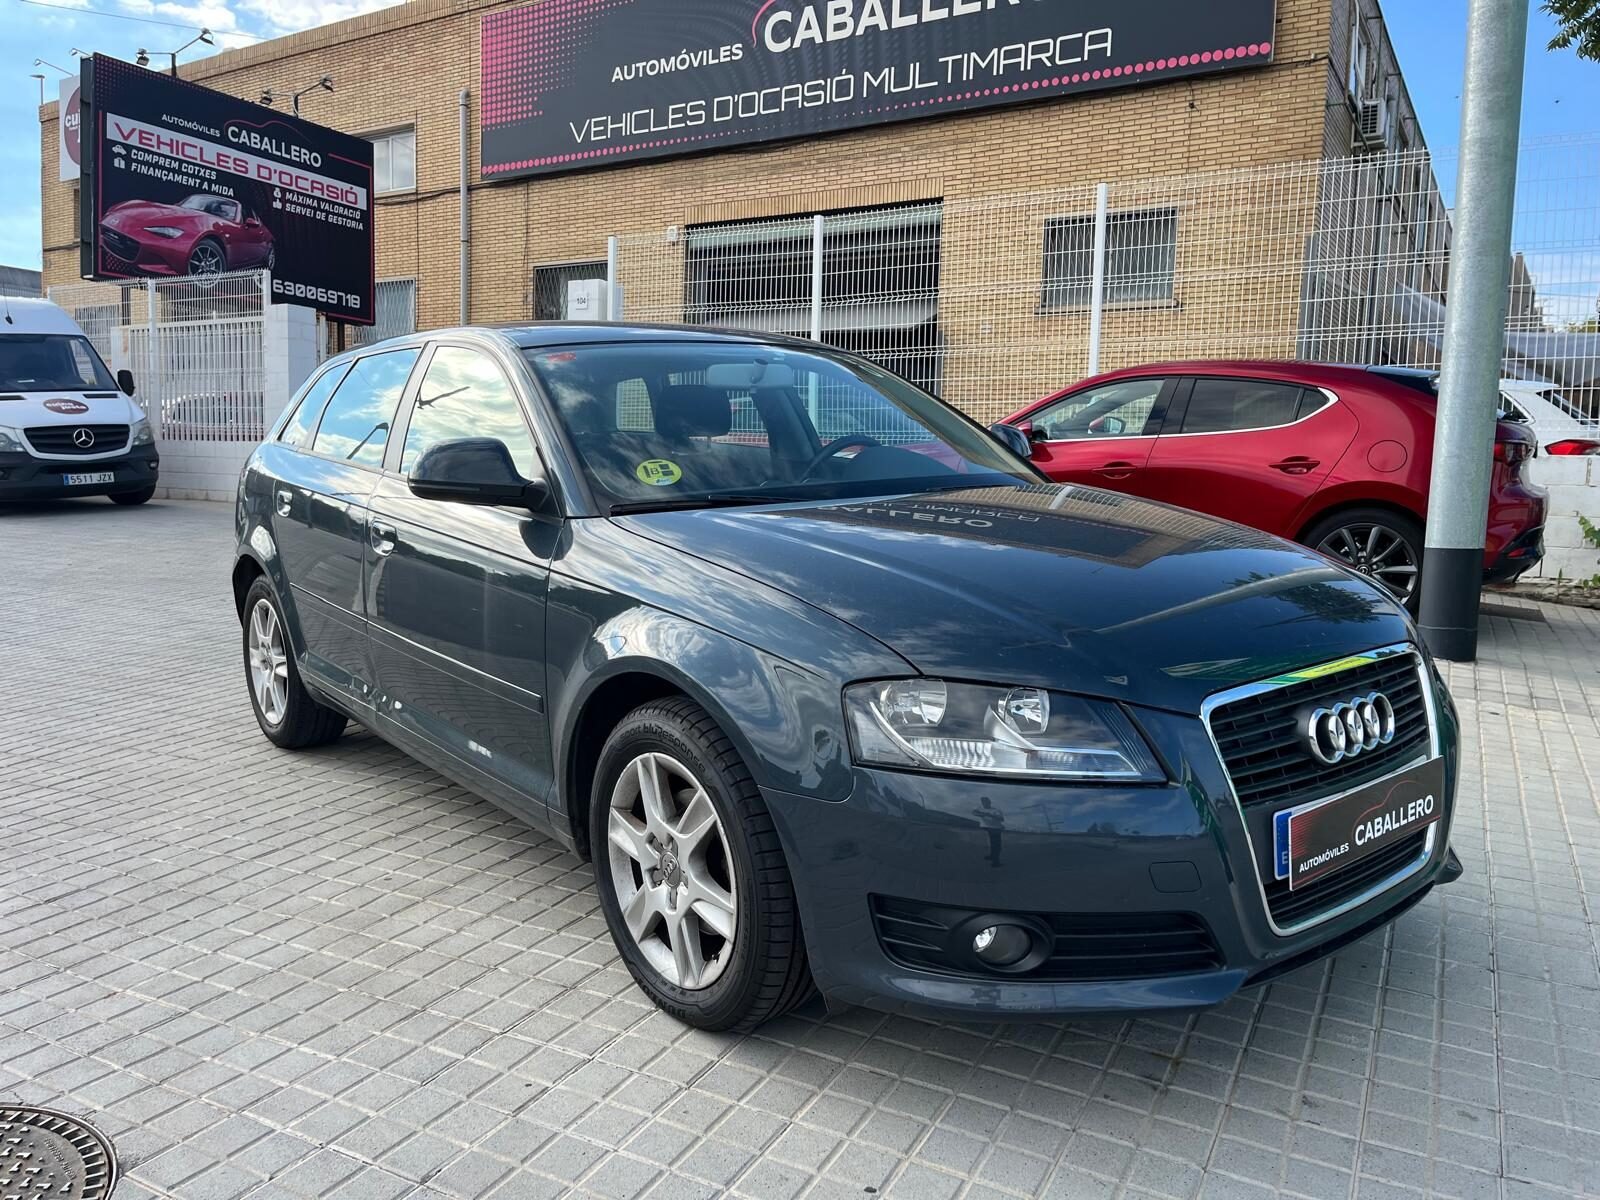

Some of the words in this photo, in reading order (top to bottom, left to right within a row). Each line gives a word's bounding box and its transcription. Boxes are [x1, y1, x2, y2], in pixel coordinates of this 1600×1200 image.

[611, 43, 743, 83] AUTOMÓVILES
[569, 100, 706, 144] VEHICLES
[713, 68, 854, 122] D'OCASIÓ
[863, 27, 1112, 98] MULTIMARCA
[161, 113, 221, 138] AUTOMÓVILES
[227, 126, 322, 167] CABALLERO
[114, 121, 249, 175] VEHICLES
[256, 163, 358, 206] D'OCASIÓ
[131, 148, 179, 170] COMPREM
[181, 162, 217, 180] COTXES
[131, 162, 201, 188] FINANÇAMENT
[202, 181, 209, 191] A
[211, 184, 234, 197] MIDA
[285, 203, 314, 218] SERVEI
[315, 211, 326, 221] DE
[327, 214, 364, 231] GESTORIA
[320, 200, 361, 219] VALORACIÓ
[272, 279, 361, 309] 630069718
[70, 475, 93, 484] 5511
[96, 473, 113, 482] JZX
[1299, 842, 1350, 873] AUTOMÓVILES
[1355, 794, 1434, 846] CABALLERO
